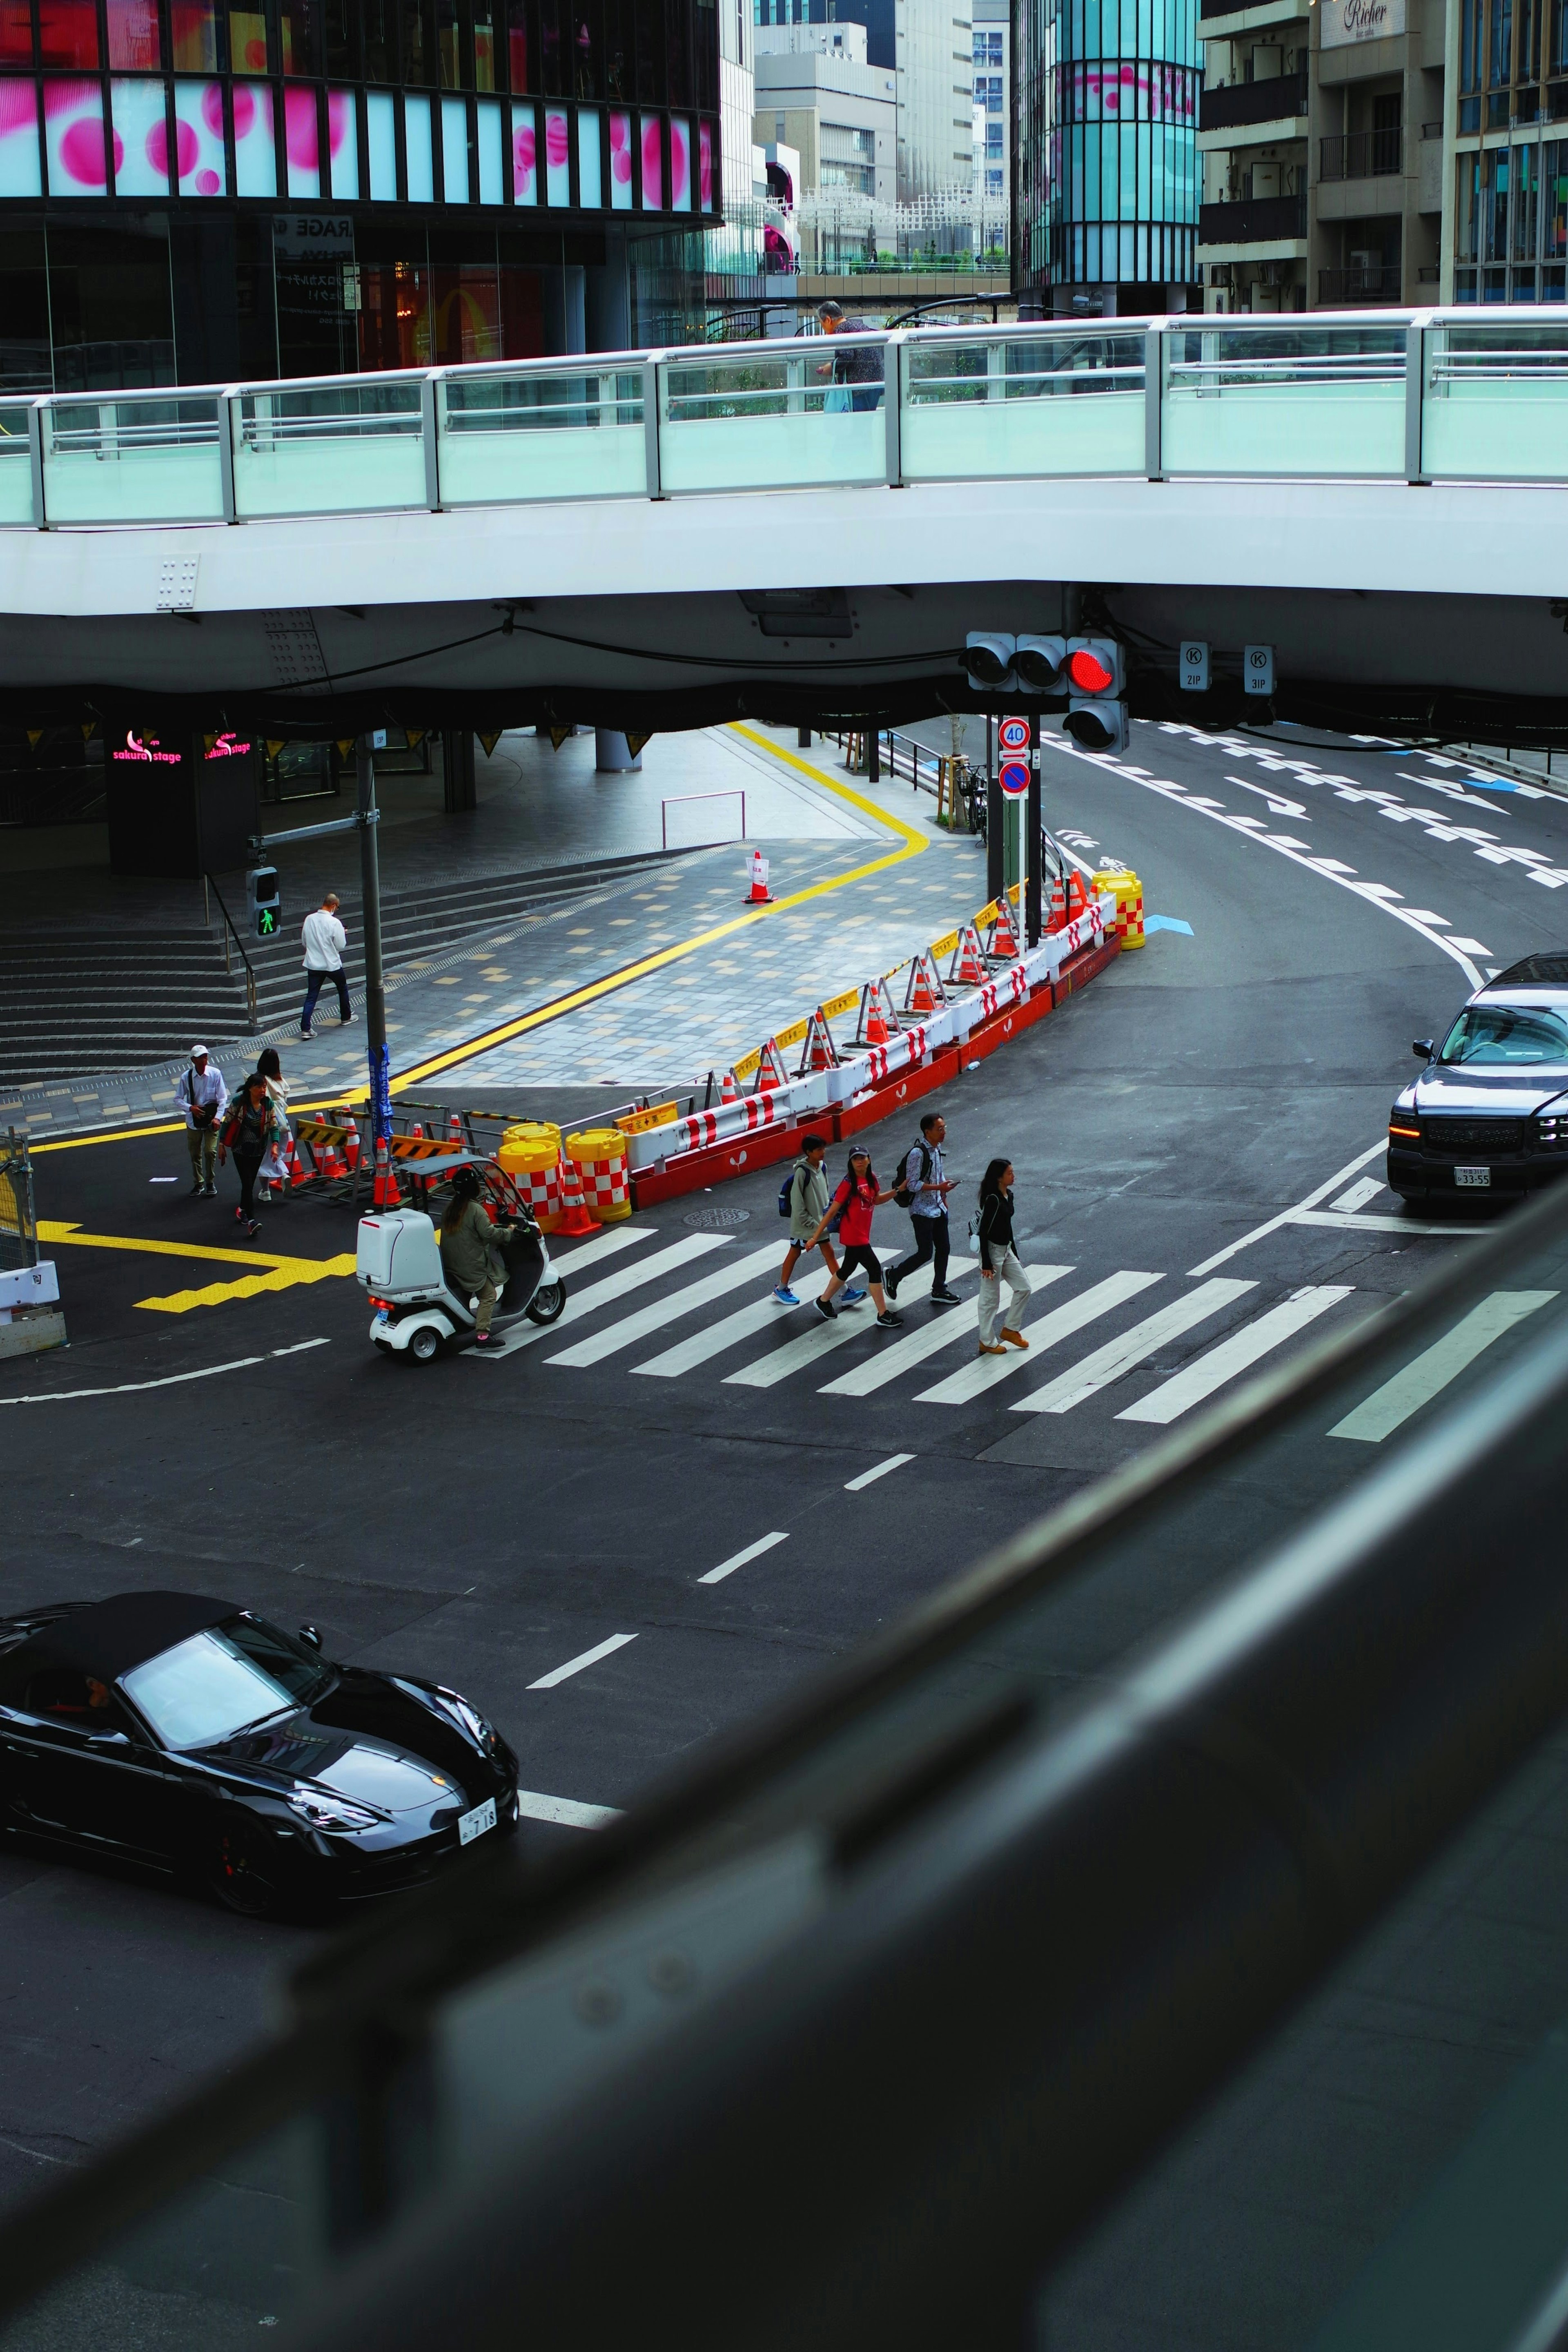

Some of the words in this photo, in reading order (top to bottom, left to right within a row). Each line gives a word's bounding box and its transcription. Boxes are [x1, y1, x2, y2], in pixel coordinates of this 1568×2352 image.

[1344, 0, 1387, 31] Richer
[1007, 727, 1023, 741] 40
[232, 743, 250, 754] stage
[114, 750, 147, 760] sakura
[153, 752, 181, 764] stage
[1463, 1175, 1489, 1184] 33-55
